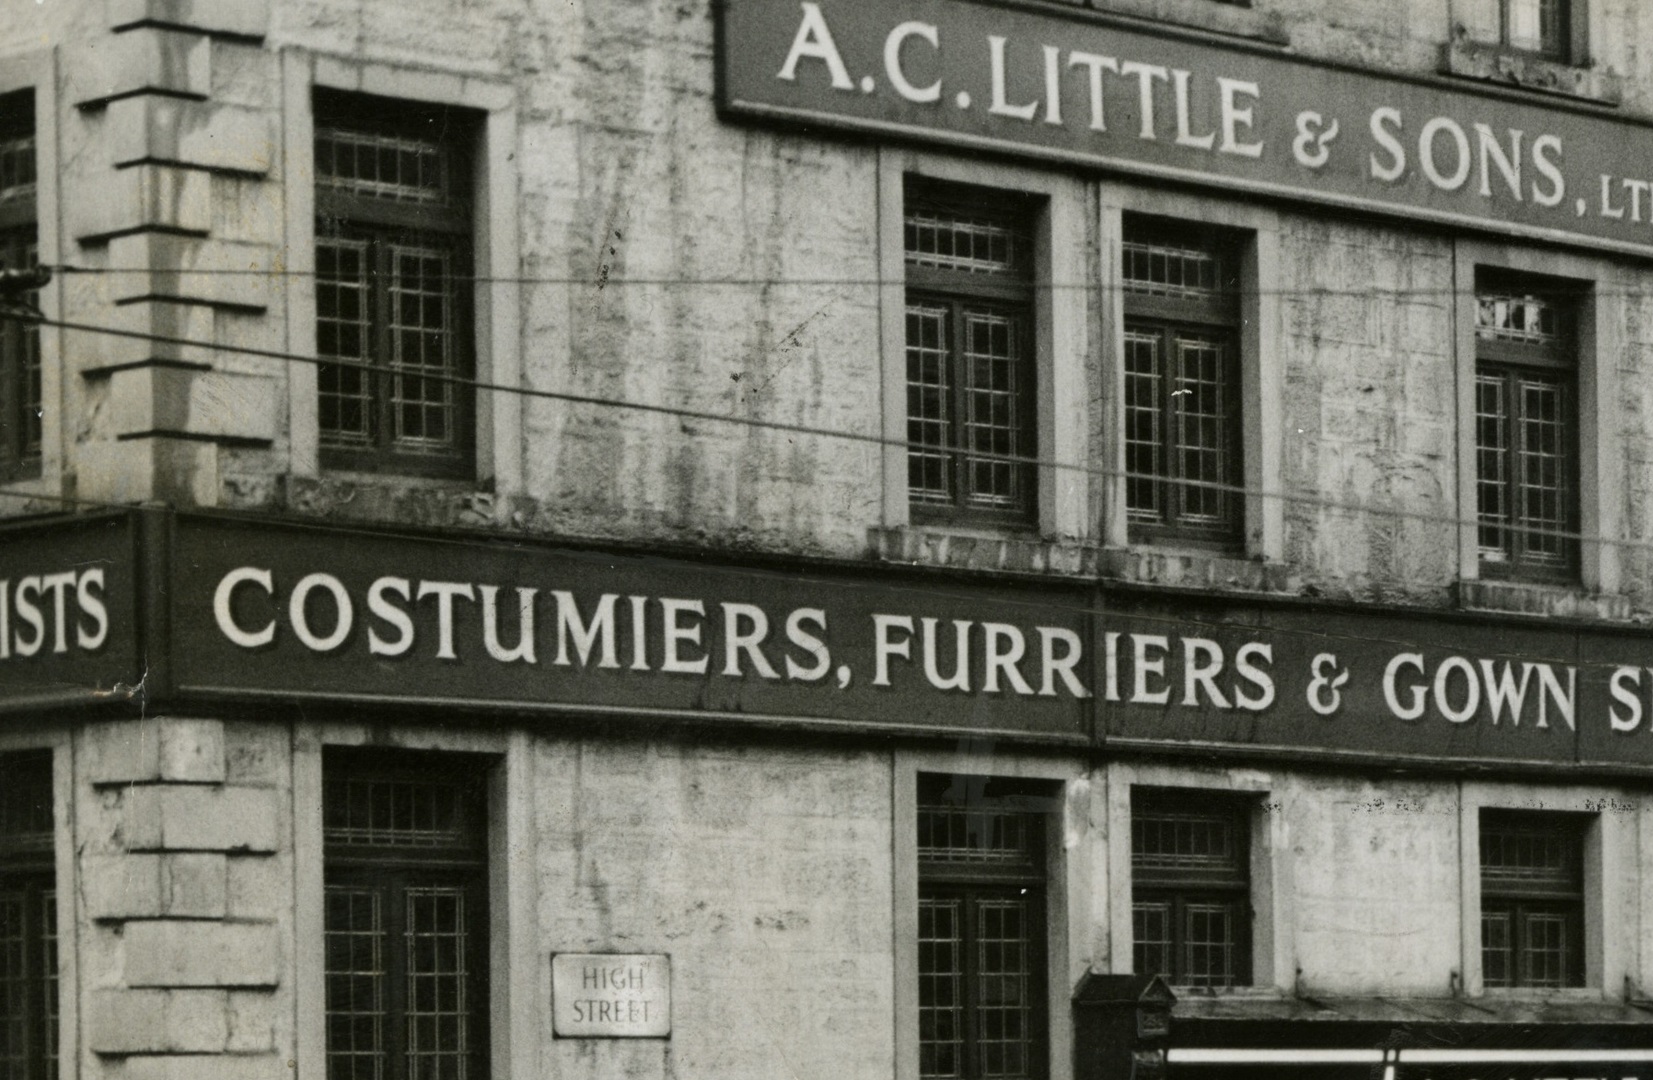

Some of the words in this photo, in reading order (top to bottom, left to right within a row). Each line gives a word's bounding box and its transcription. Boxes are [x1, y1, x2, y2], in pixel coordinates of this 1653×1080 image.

[987, 35, 1265, 157] LITTLE
[1291, 109, 1340, 168] &
[1368, 105, 1587, 217] SONS,
[0, 568, 109, 658] ISTS
[212, 566, 852, 690] COSTUMIERS,
[872, 613, 1276, 711] FURRIERS
[1305, 652, 1350, 716] &
[1381, 651, 1577, 731] GOWN
[572, 999, 654, 1024] STREET
[582, 965, 646, 991] HIGH
